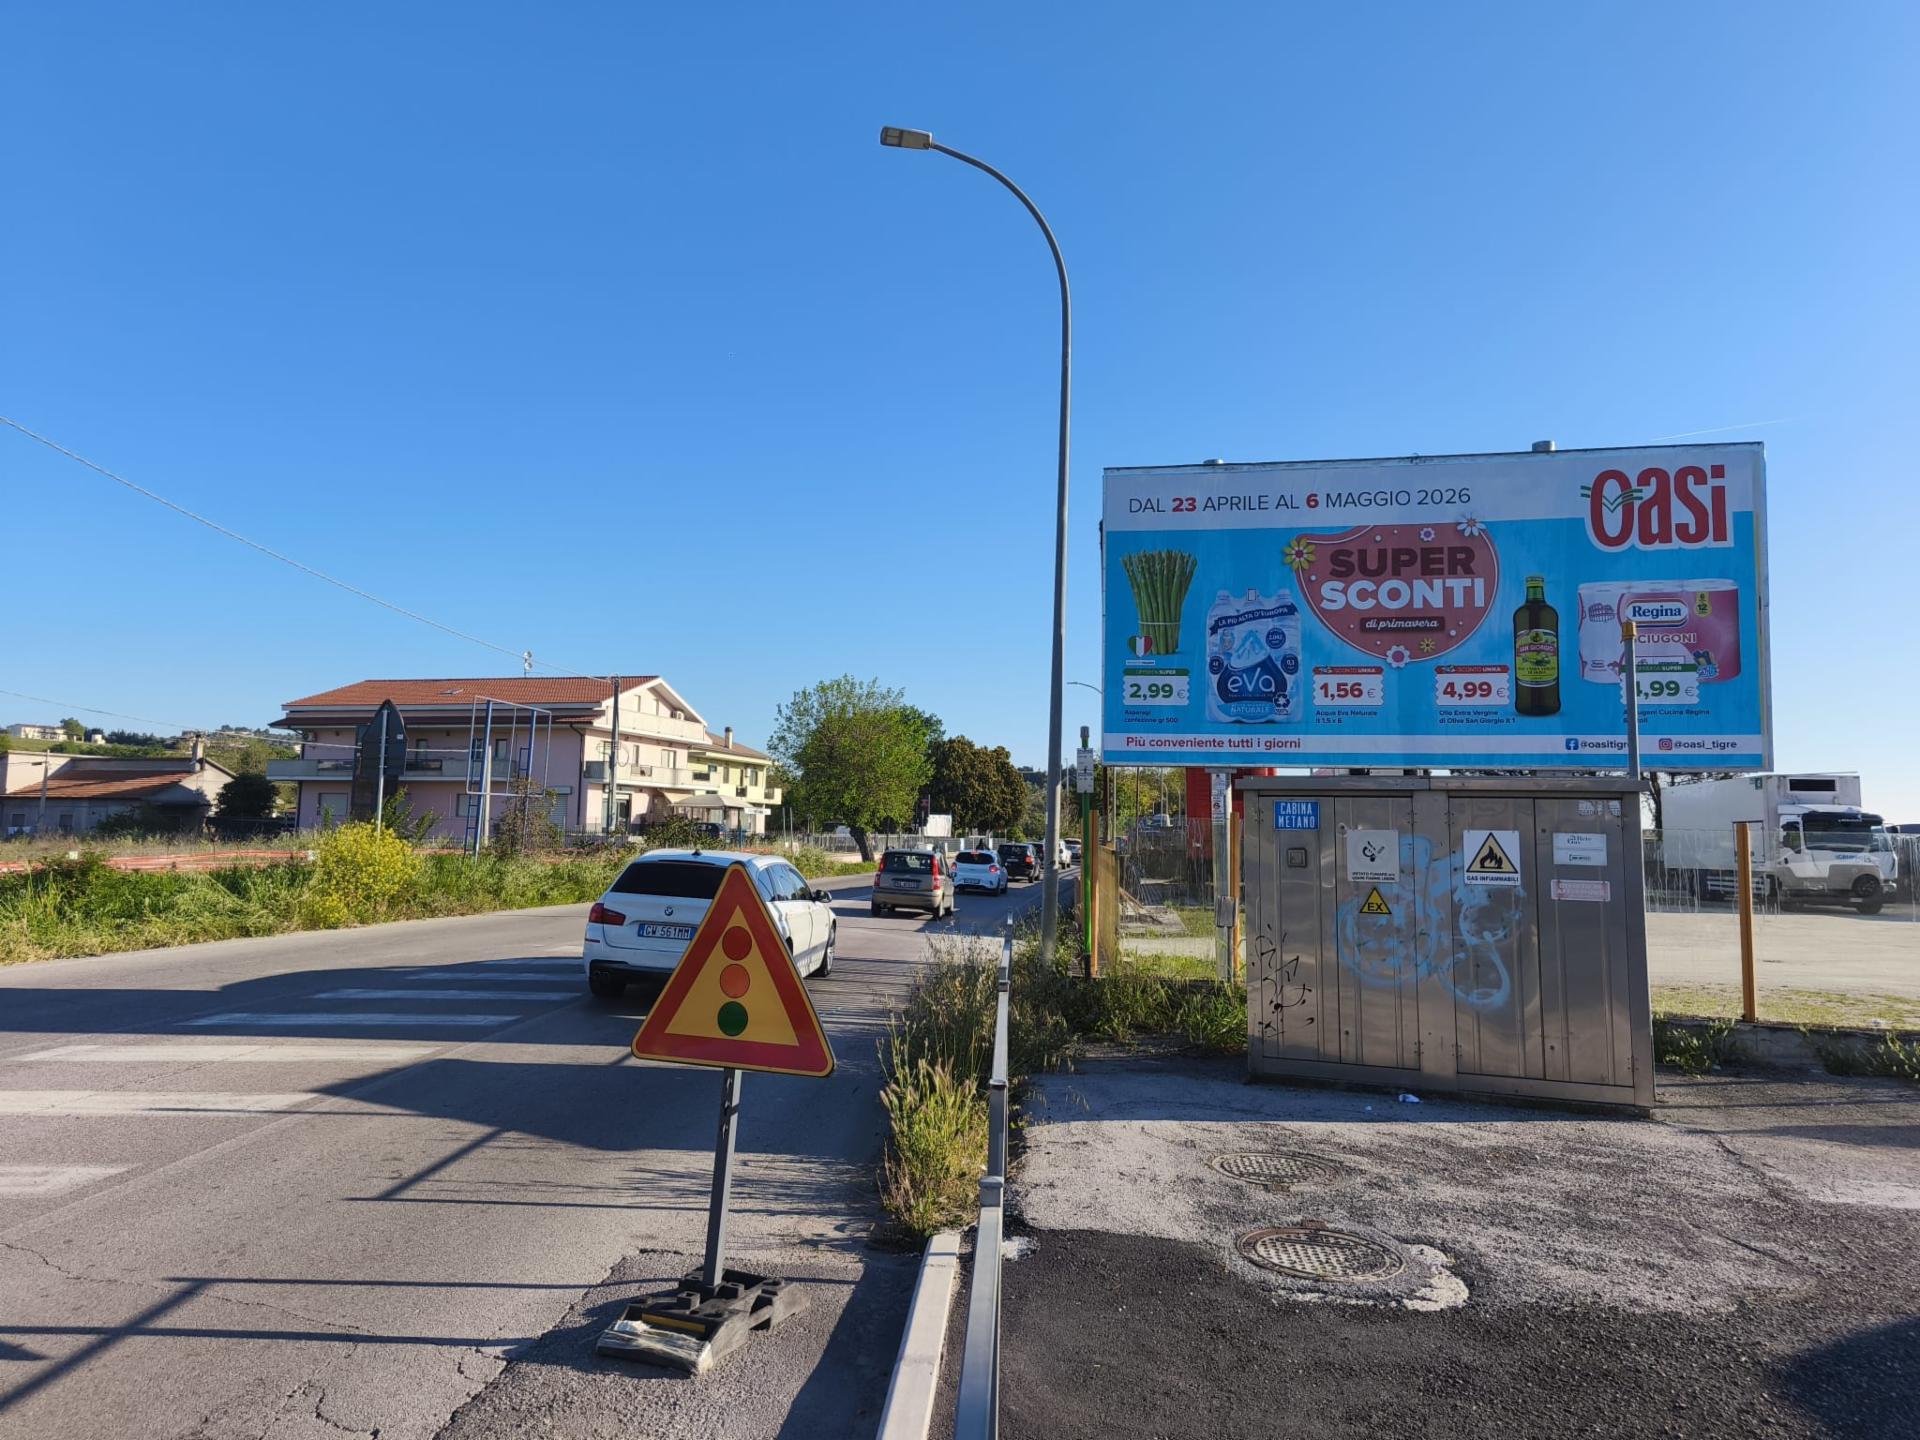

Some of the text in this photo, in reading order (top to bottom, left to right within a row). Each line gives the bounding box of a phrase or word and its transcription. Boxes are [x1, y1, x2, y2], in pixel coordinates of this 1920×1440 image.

[1129, 488, 1471, 513] DAL 23 APRILE AL 6 MAGGIO 2026
[1329, 545, 1476, 578] SUPER
[1320, 577, 1485, 610] SCONTI
[1632, 605, 1681, 619] Regina
[1697, 603, 1708, 611] 12
[1365, 617, 1439, 630] di primavera
[1634, 633, 1696, 644] CIUGONI
[1129, 683, 1186, 700] 2,99 €
[1320, 682, 1376, 700] 1,56 €
[1443, 681, 1506, 700] 4,99 €
[1685, 686, 1695, 696] €
[1126, 736, 1146, 747] Più
[1149, 737, 1224, 748] conveniente
[1228, 737, 1254, 748] tutti
[1265, 737, 1301, 750] giorni
[1580, 738, 1629, 750] @oasitigr
[1674, 738, 1737, 750] @oasi_tigre
[1280, 802, 1312, 815] CABINA
[1278, 815, 1315, 828] METANO
[1367, 902, 1383, 912] EX
